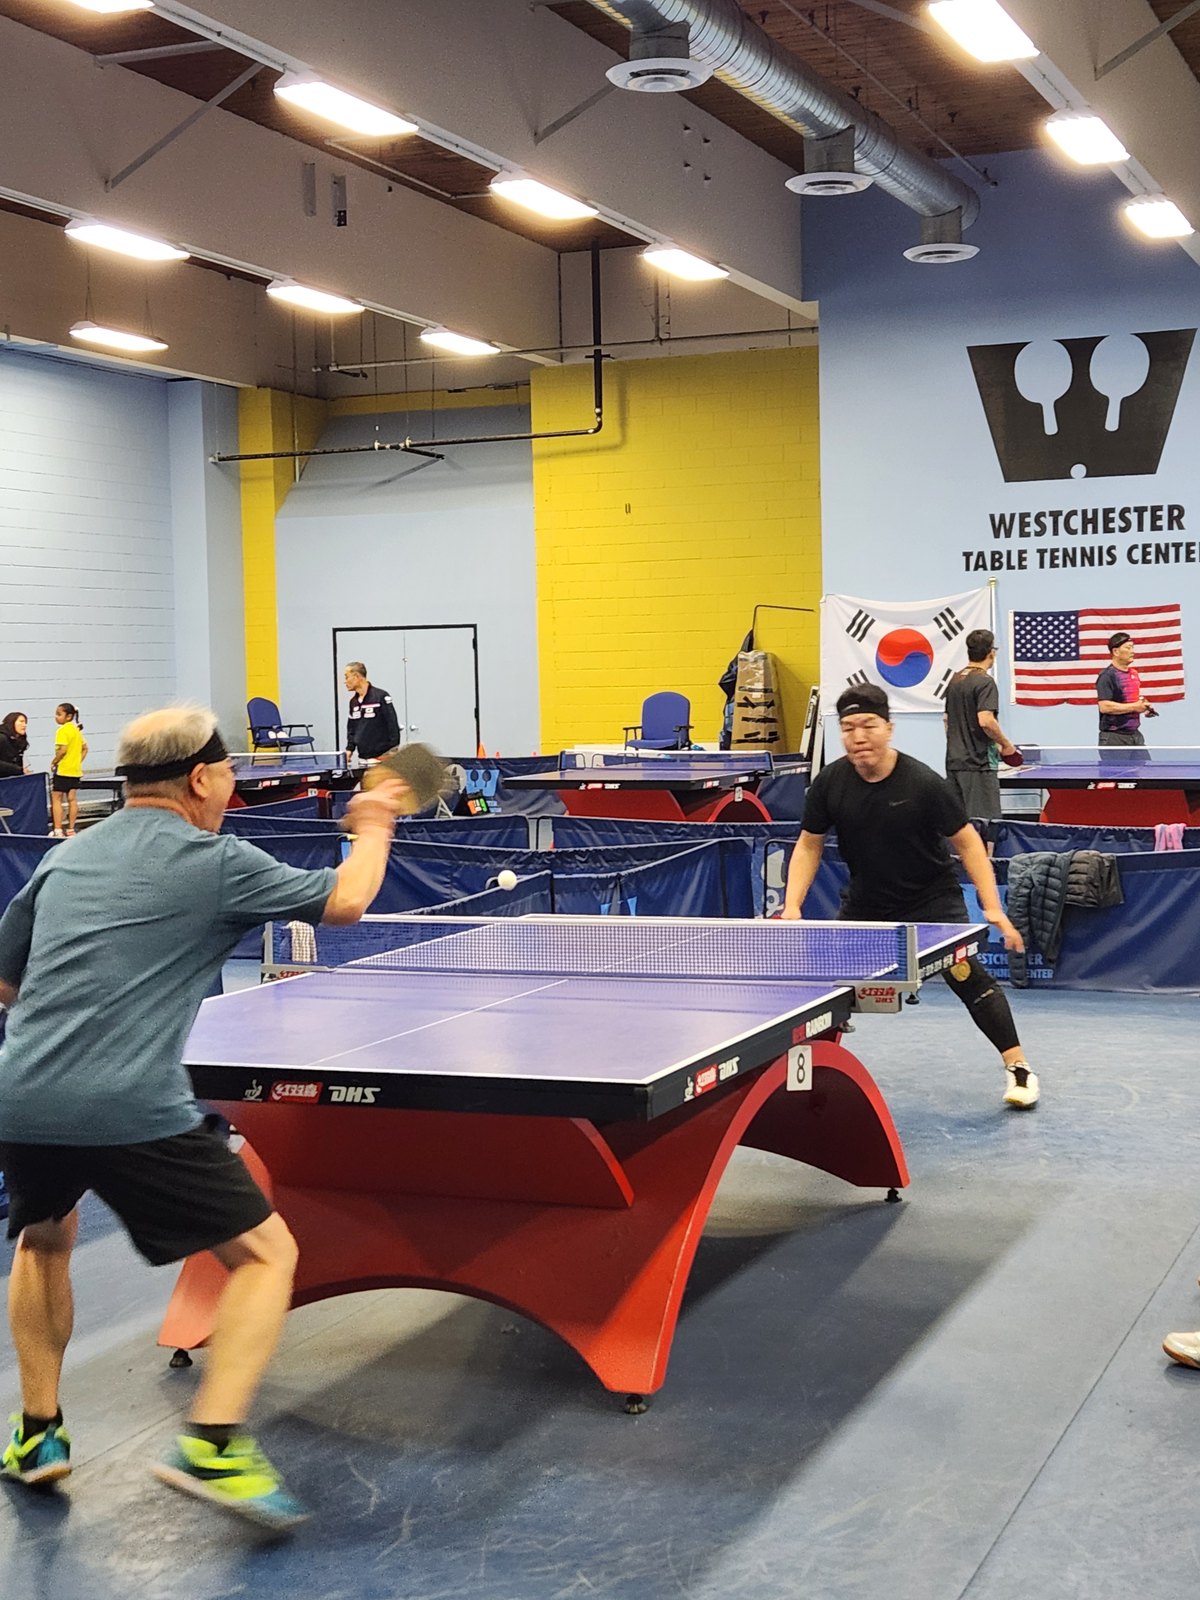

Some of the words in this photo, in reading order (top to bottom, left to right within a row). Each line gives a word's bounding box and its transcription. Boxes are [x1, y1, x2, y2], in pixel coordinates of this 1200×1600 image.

[989, 504, 1186, 539] WESTCHESTER
[962, 549, 1028, 572] TABLE
[1036, 545, 1117, 569] TENNIS
[1127, 542, 1200, 565] CENTE
[1026, 968, 1054, 979] ENTER
[796, 1053, 805, 1083] 8
[328, 1085, 382, 1103] DHS
